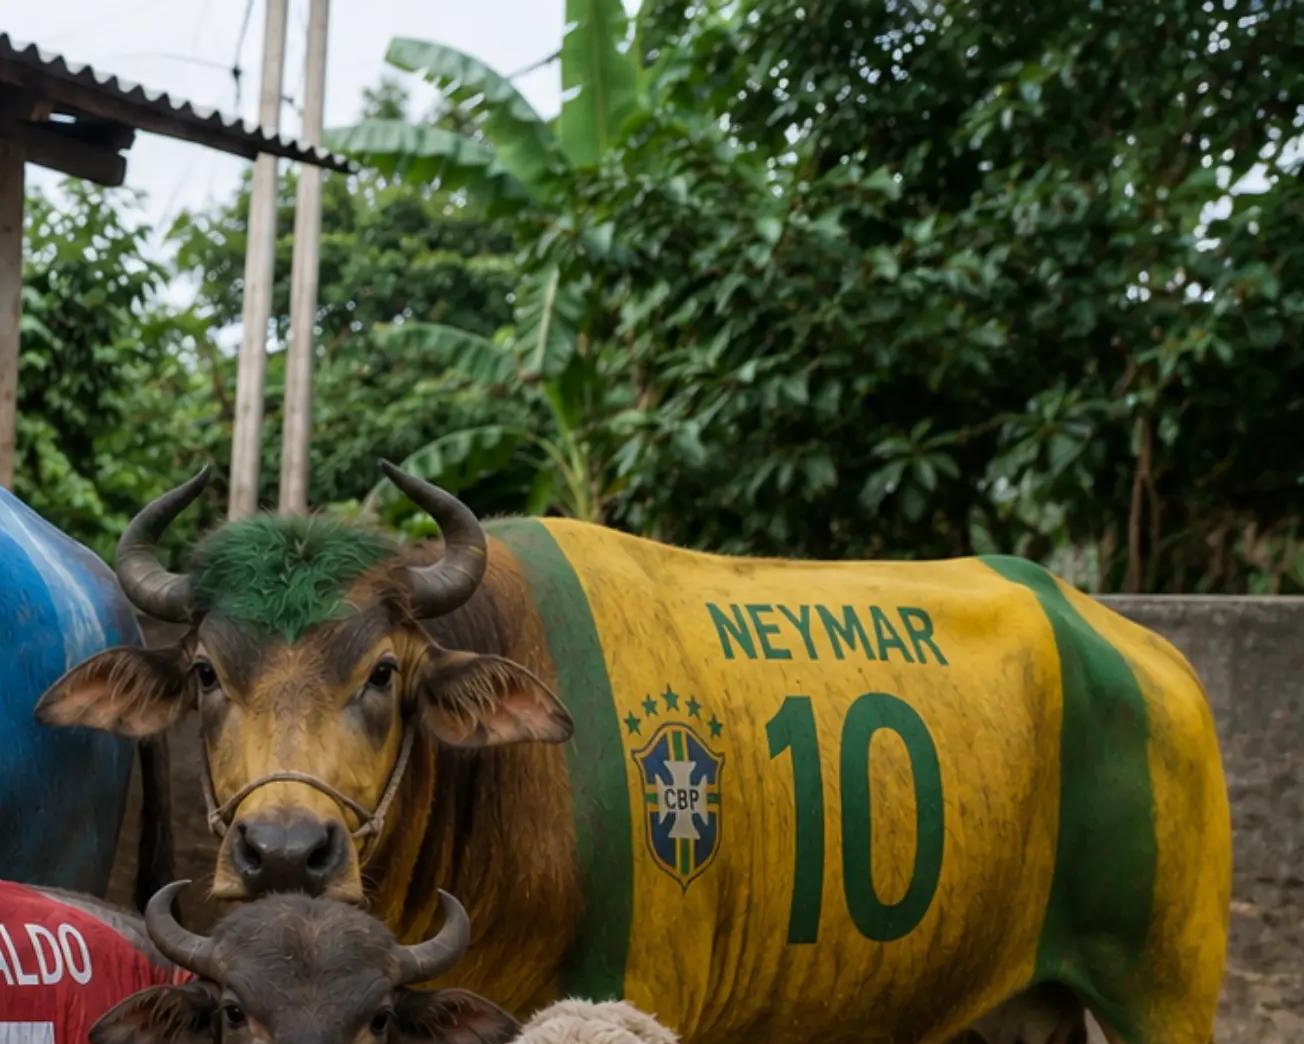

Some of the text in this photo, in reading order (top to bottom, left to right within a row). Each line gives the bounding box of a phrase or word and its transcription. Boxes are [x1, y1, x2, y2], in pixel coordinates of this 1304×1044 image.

[706, 602, 949, 666] NEYMAR
[664, 788, 700, 811] CBP
[766, 692, 944, 944] 10
